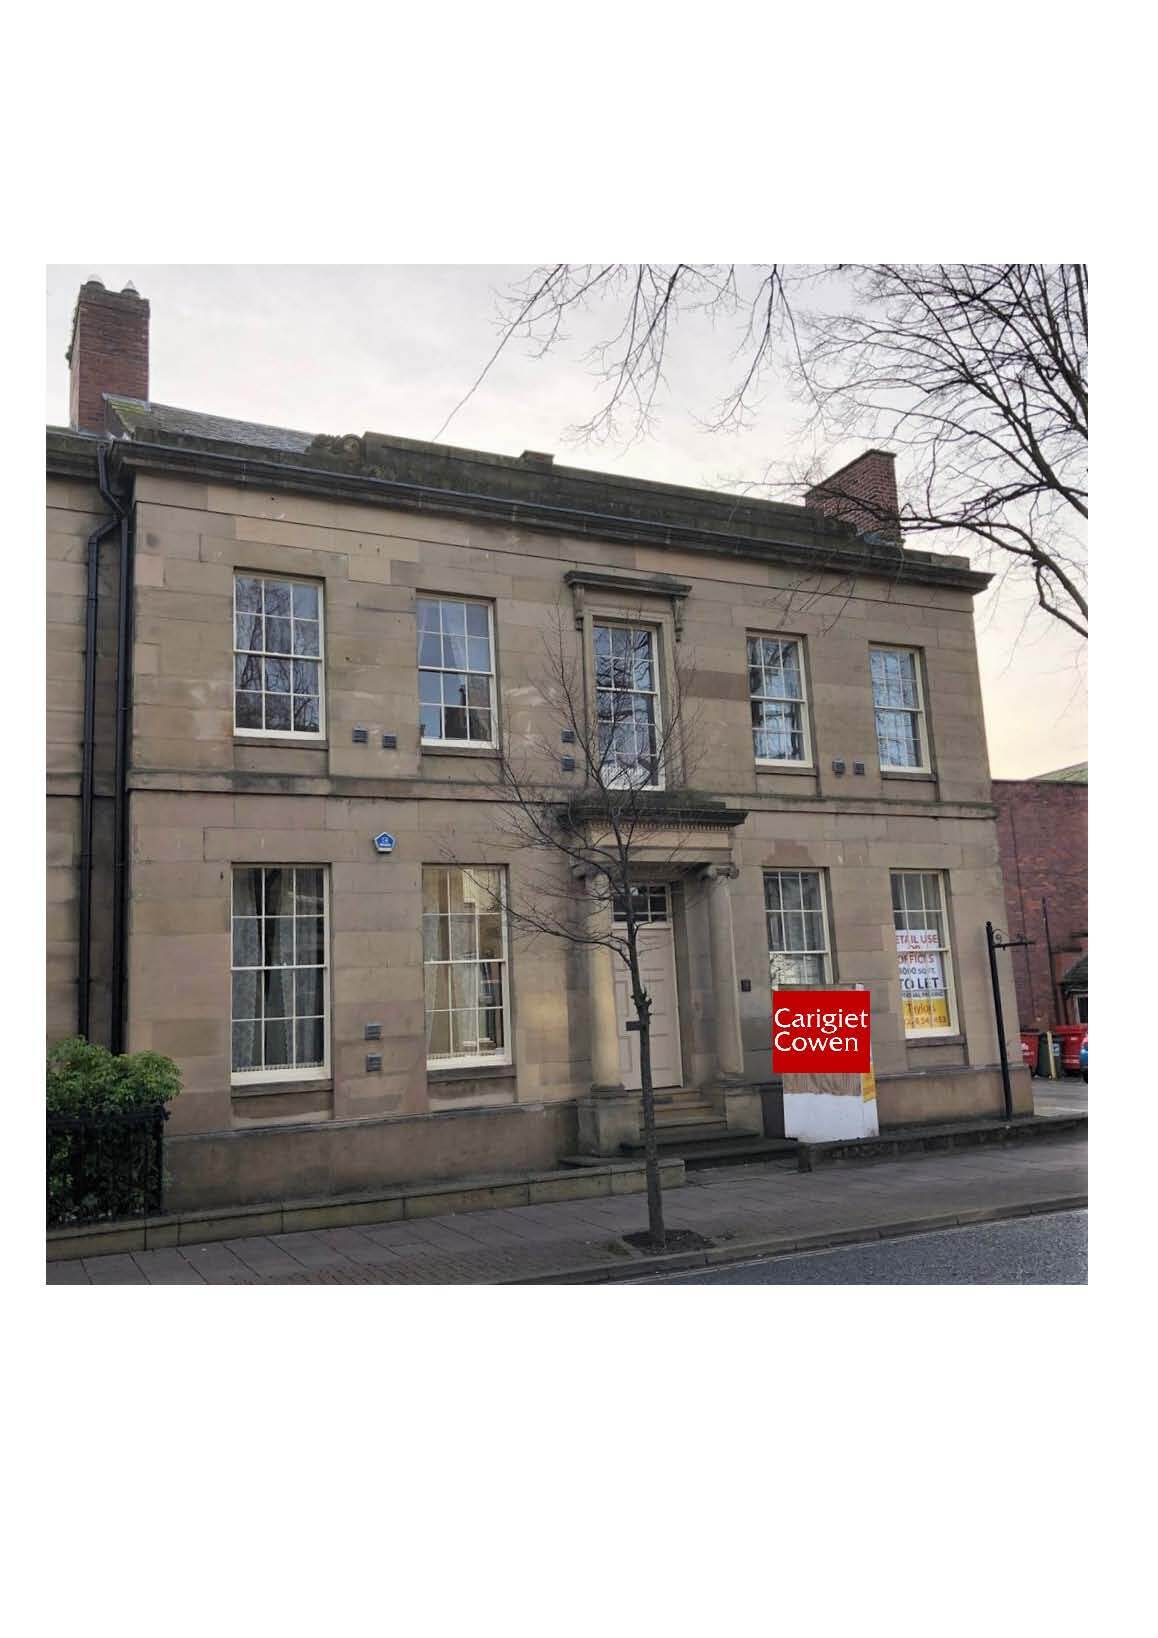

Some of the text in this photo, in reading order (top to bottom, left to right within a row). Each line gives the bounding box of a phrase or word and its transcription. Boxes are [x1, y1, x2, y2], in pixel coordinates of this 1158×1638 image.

[920, 934, 938, 944] USE
[897, 952, 935, 964] OFFICS
[917, 976, 939, 989] LET
